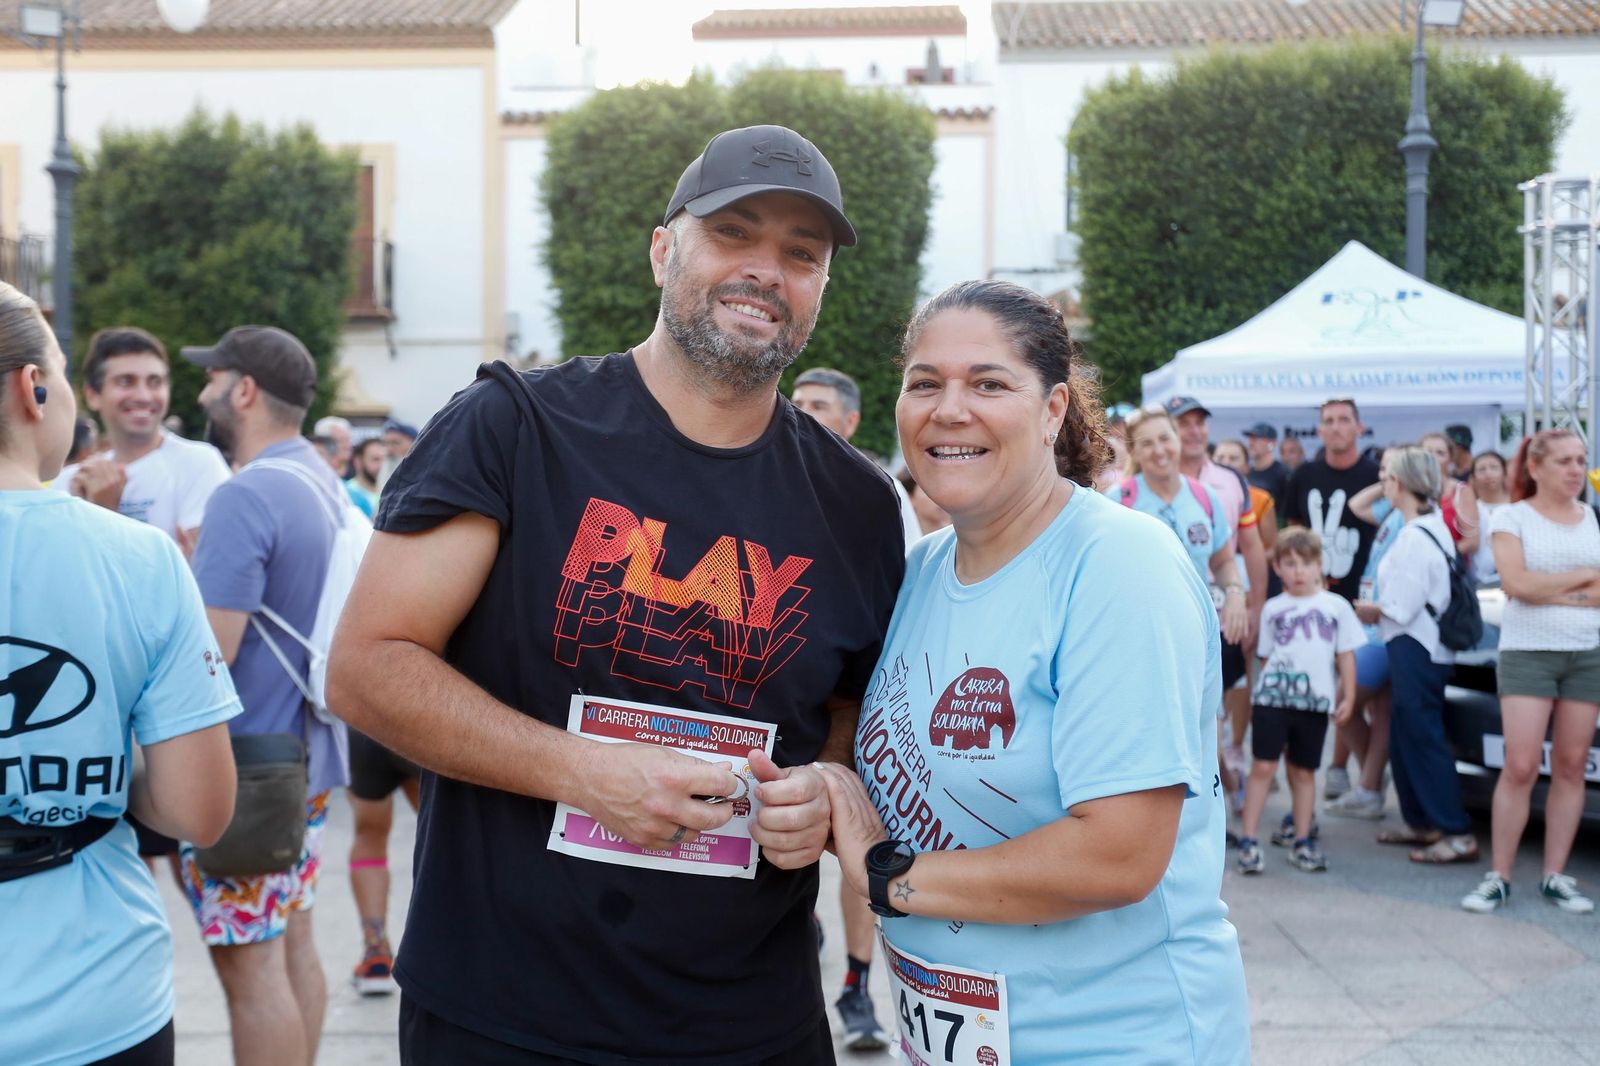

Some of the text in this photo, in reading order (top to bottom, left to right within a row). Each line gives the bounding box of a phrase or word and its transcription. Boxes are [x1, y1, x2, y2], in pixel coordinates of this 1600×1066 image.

[1463, 369, 1566, 384] DEPORIA
[561, 497, 814, 630] PLAY
[586, 706, 764, 749] VI CARRERA NOCTURNA SOLIDARIA
[635, 731, 719, 751] corre por la igualdad
[888, 682, 932, 792] VI CARRERA
[932, 712, 986, 736] SOLIDARIA
[937, 750, 951, 758] corre
[952, 753, 962, 761] por
[859, 707, 967, 851] NOCTURN
[939, 973, 996, 998] SOLIDARIA
[900, 988, 965, 1063] 417
